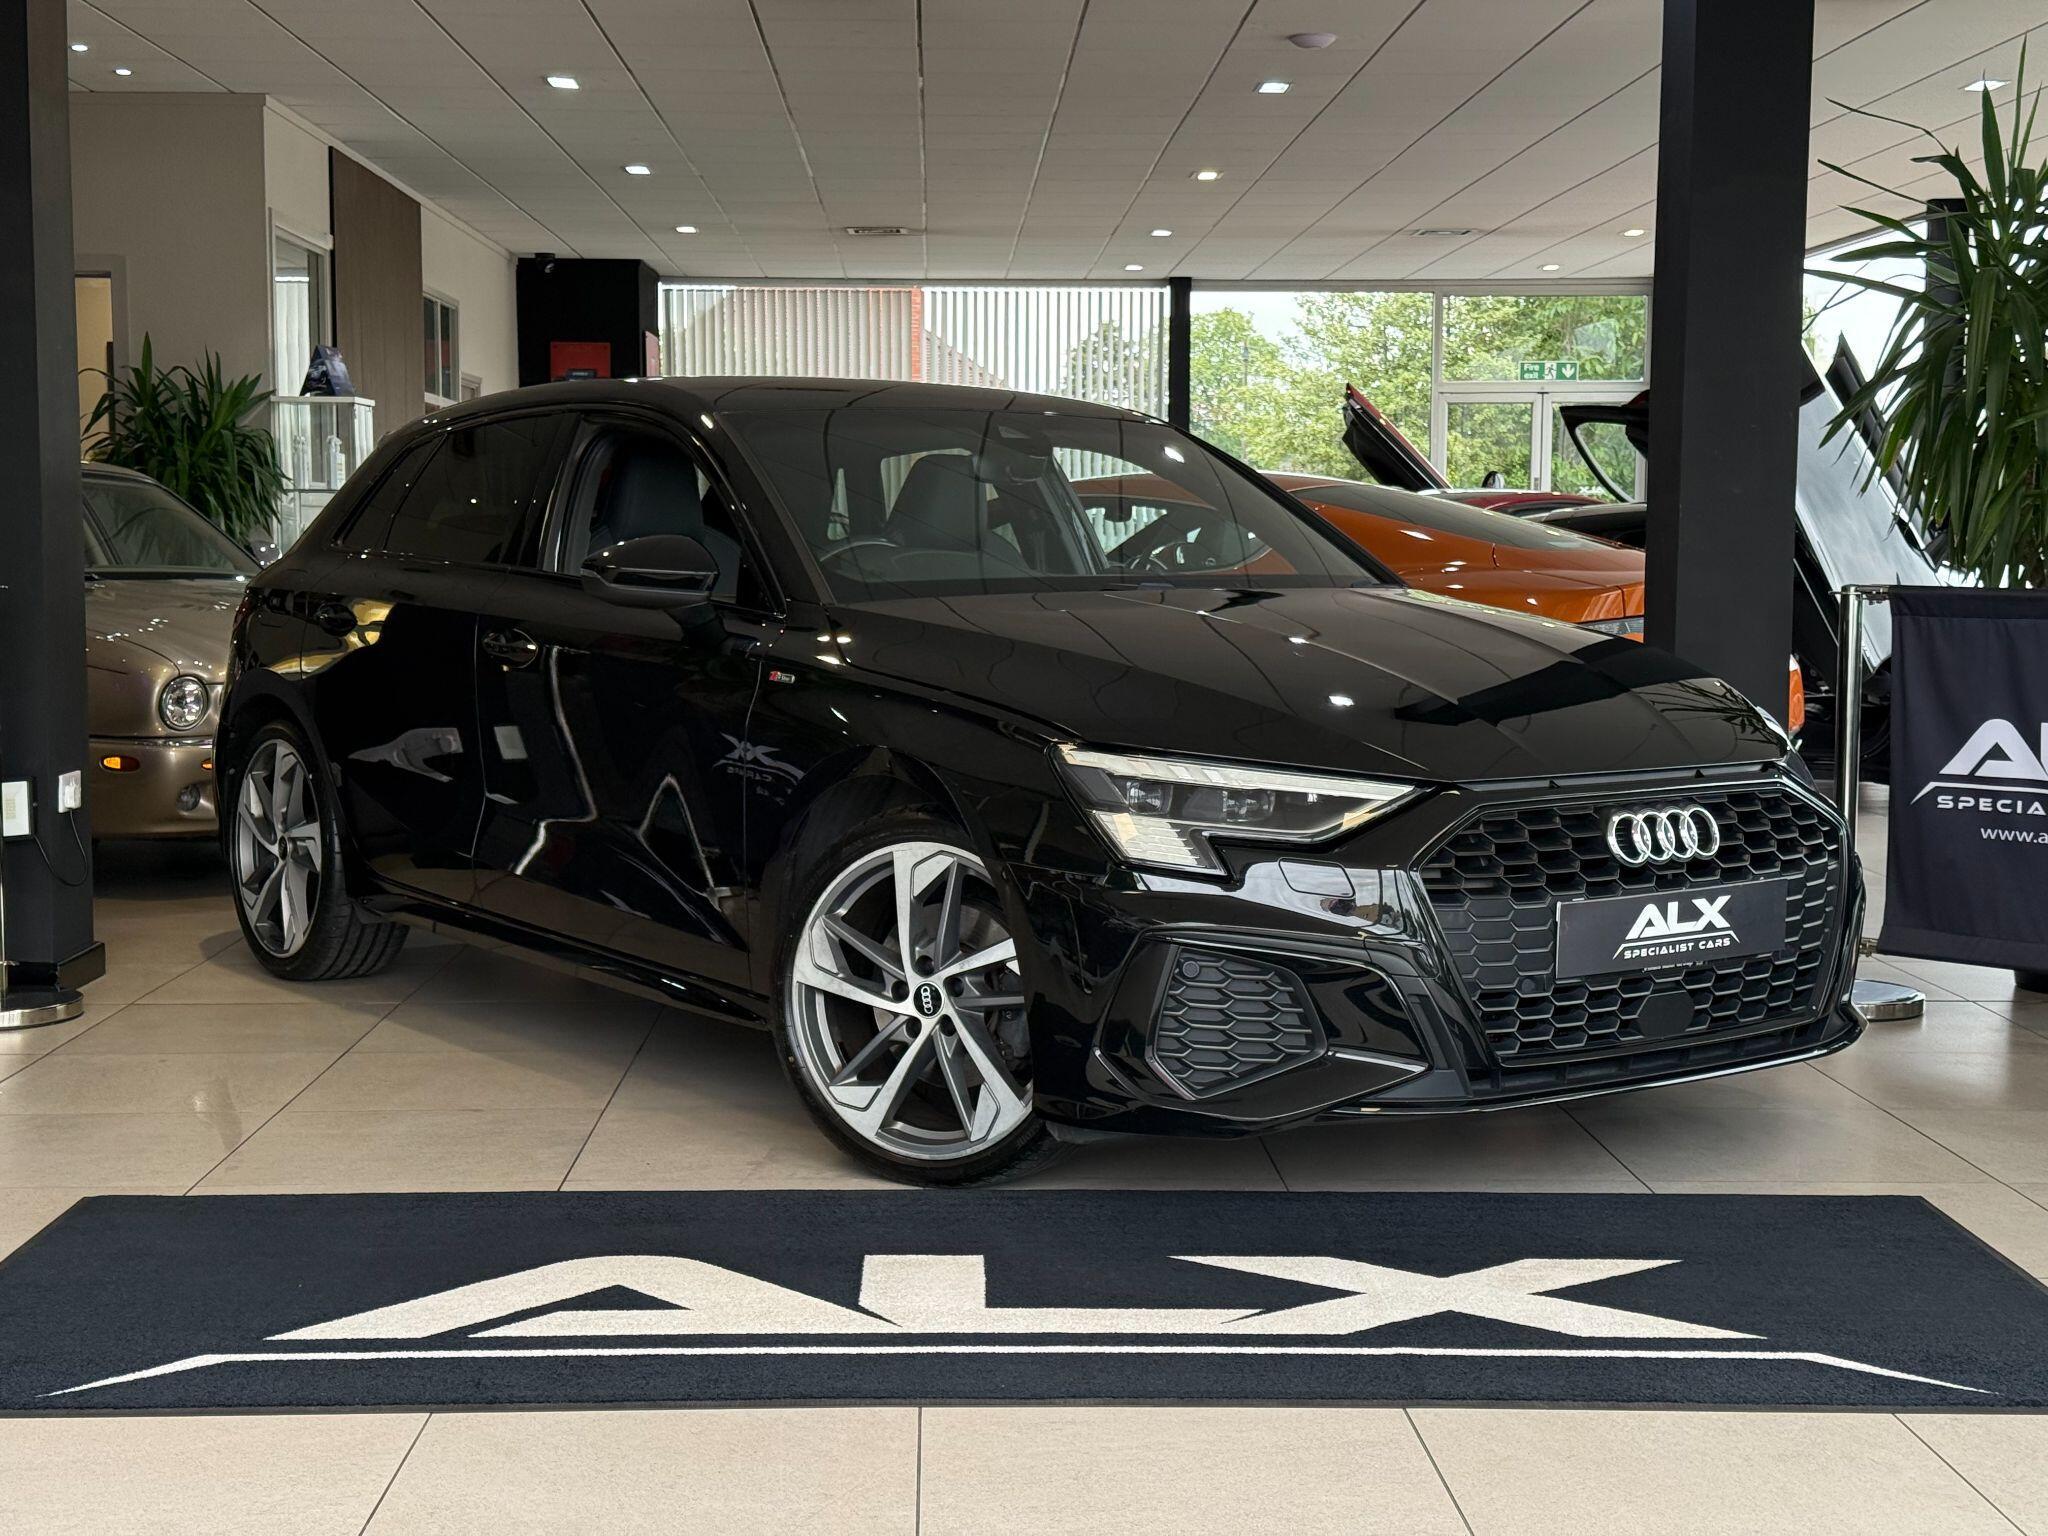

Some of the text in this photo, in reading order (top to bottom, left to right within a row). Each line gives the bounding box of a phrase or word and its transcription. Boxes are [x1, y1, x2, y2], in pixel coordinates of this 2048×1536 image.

[1625, 895, 1732, 940] ALX
[1623, 937, 1731, 960] SPECIALIST CARS
[263, 1253, 1768, 1341] ALX
